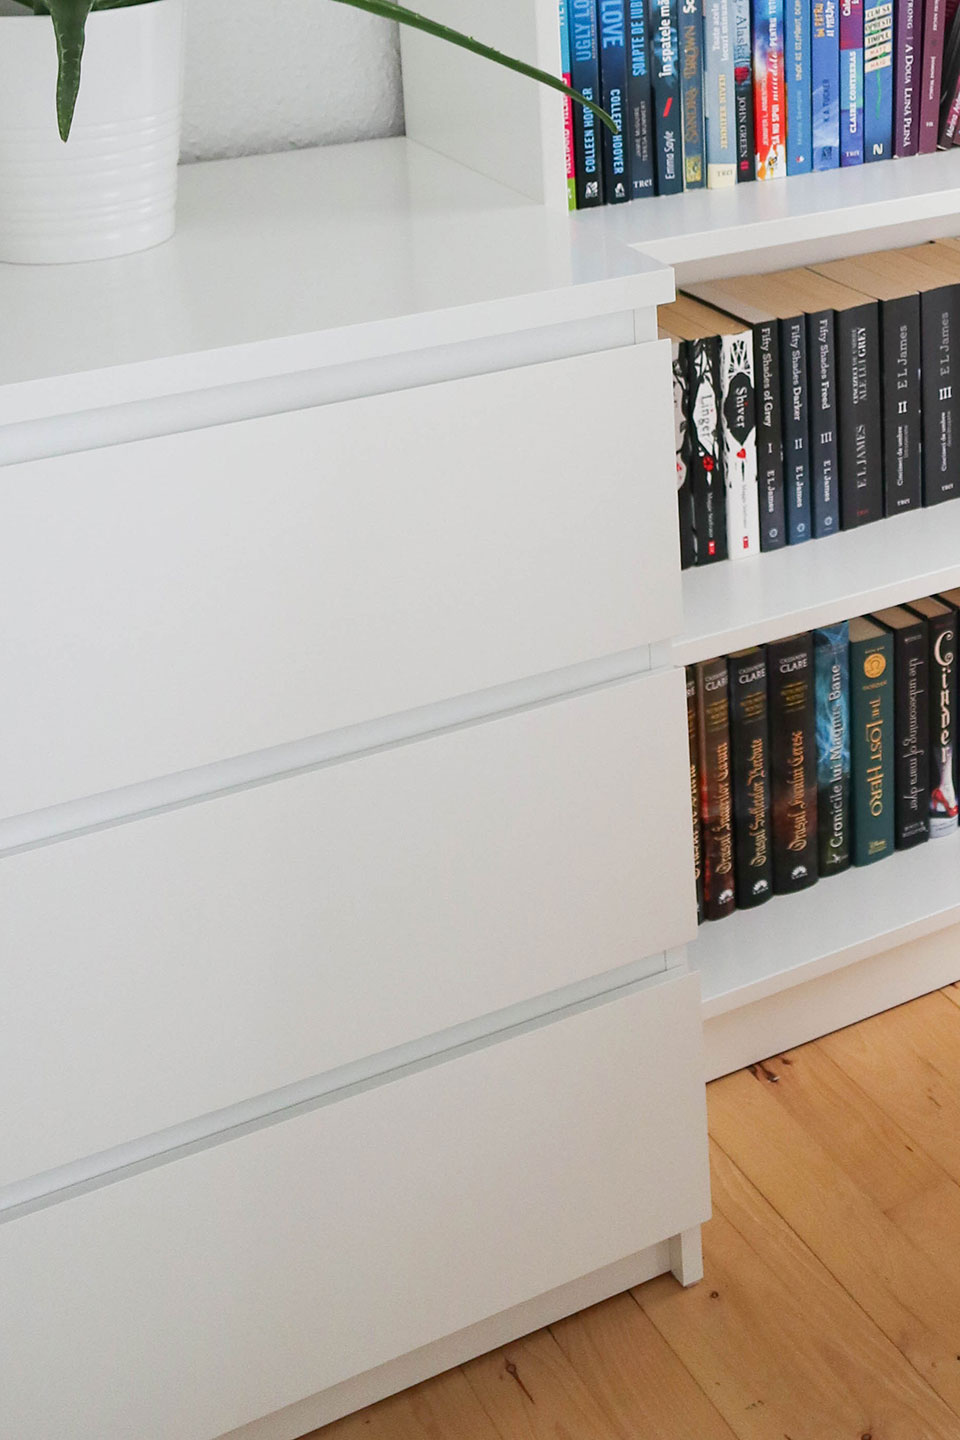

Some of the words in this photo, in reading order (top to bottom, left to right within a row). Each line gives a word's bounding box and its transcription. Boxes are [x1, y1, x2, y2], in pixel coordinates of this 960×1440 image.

[602, 0, 624, 48] LOVE
[630, 22, 643, 36] DE
[573, 23, 593, 62] UGLY
[657, 20, 673, 62] spatele
[720, 35, 729, 61] locuri
[631, 38, 648, 77] ȘOAPTE
[657, 65, 672, 78] În
[848, 51, 858, 100] CONTRERAS
[737, 96, 747, 124] JOHN
[848, 102, 857, 133] CLAIRE
[738, 125, 748, 157] GREEN
[760, 327, 771, 352] Fifty
[789, 324, 801, 348] Fifty
[818, 319, 829, 341] Fifty
[939, 311, 950, 352] James
[896, 325, 908, 367] James
[940, 354, 950, 363] L
[762, 353, 773, 389] Shades
[791, 349, 801, 385] Shades
[819, 342, 829, 380] Shades
[897, 368, 908, 377] L
[940, 367, 951, 376] E
[764, 390, 773, 401] of
[820, 381, 830, 411] Freed
[897, 379, 908, 390] E
[938, 386, 952, 400] III
[698, 394, 713, 439] Linger
[735, 386, 748, 428] Shiver
[762, 402, 773, 427] Grey
[792, 387, 802, 421] Darker
[820, 430, 832, 444] III
[855, 424, 868, 465] JAMES
[856, 466, 868, 476] L
[856, 478, 868, 489] E
[739, 668, 767, 684] CLARE
[779, 658, 808, 674] CLARE
[908, 658, 924, 676] the
[828, 664, 842, 700] Bane
[933, 629, 955, 763] Cinder
[869, 697, 882, 718] THE
[903, 678, 924, 744] unbecoming
[828, 705, 845, 760] Magnus
[865, 720, 884, 762] LOST
[903, 745, 924, 757] of
[829, 764, 843, 782] lui
[908, 758, 919, 786] mara
[866, 766, 884, 817] HERO
[903, 787, 924, 811] dyer
[829, 785, 844, 849] Cronicile
